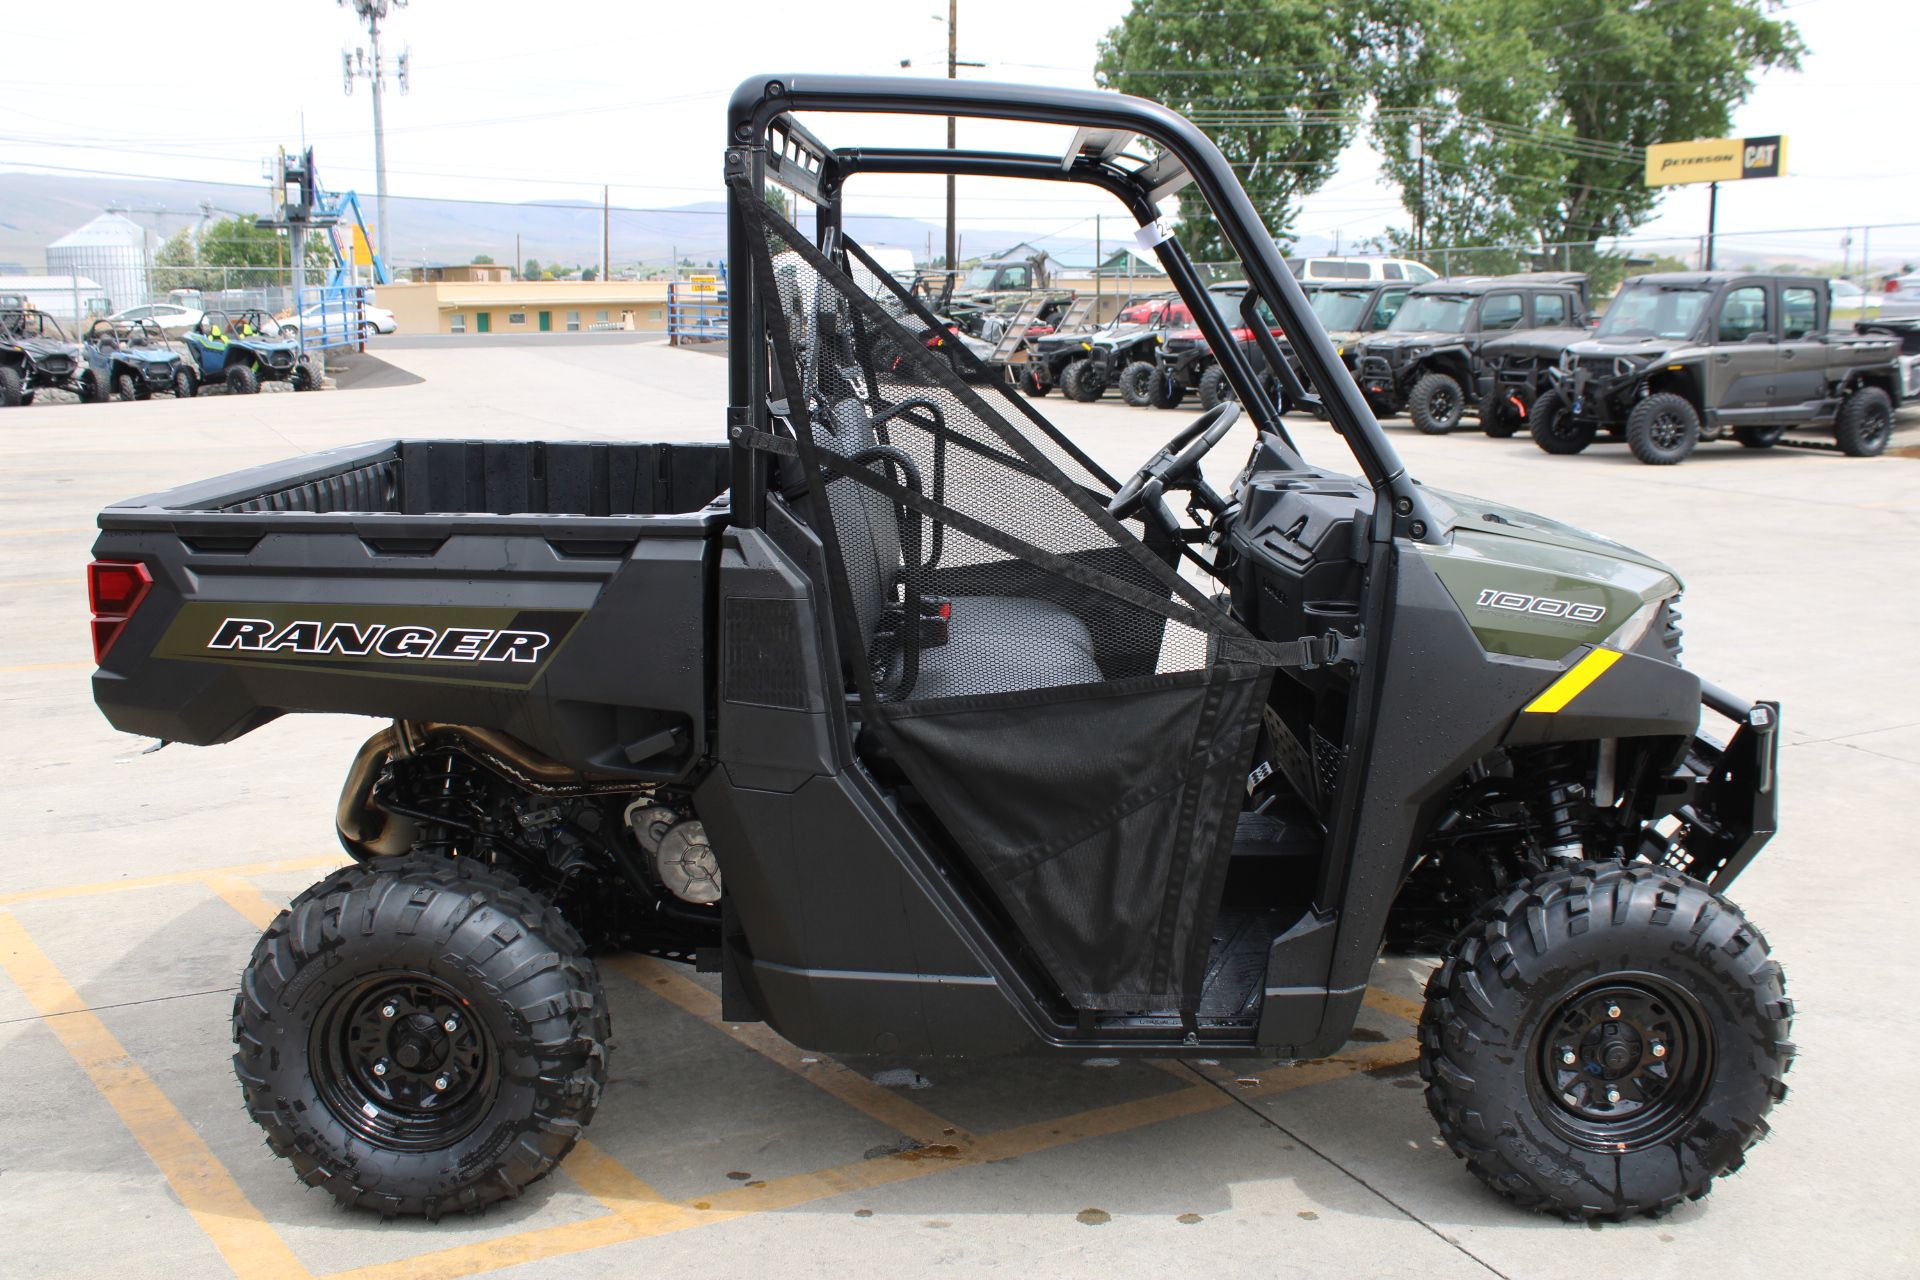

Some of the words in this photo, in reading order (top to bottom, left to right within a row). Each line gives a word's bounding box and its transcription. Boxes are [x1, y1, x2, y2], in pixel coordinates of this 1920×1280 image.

[1745, 144, 1777, 168] CAT
[1476, 589, 1606, 622] 1000
[207, 617, 550, 663] RANGER
